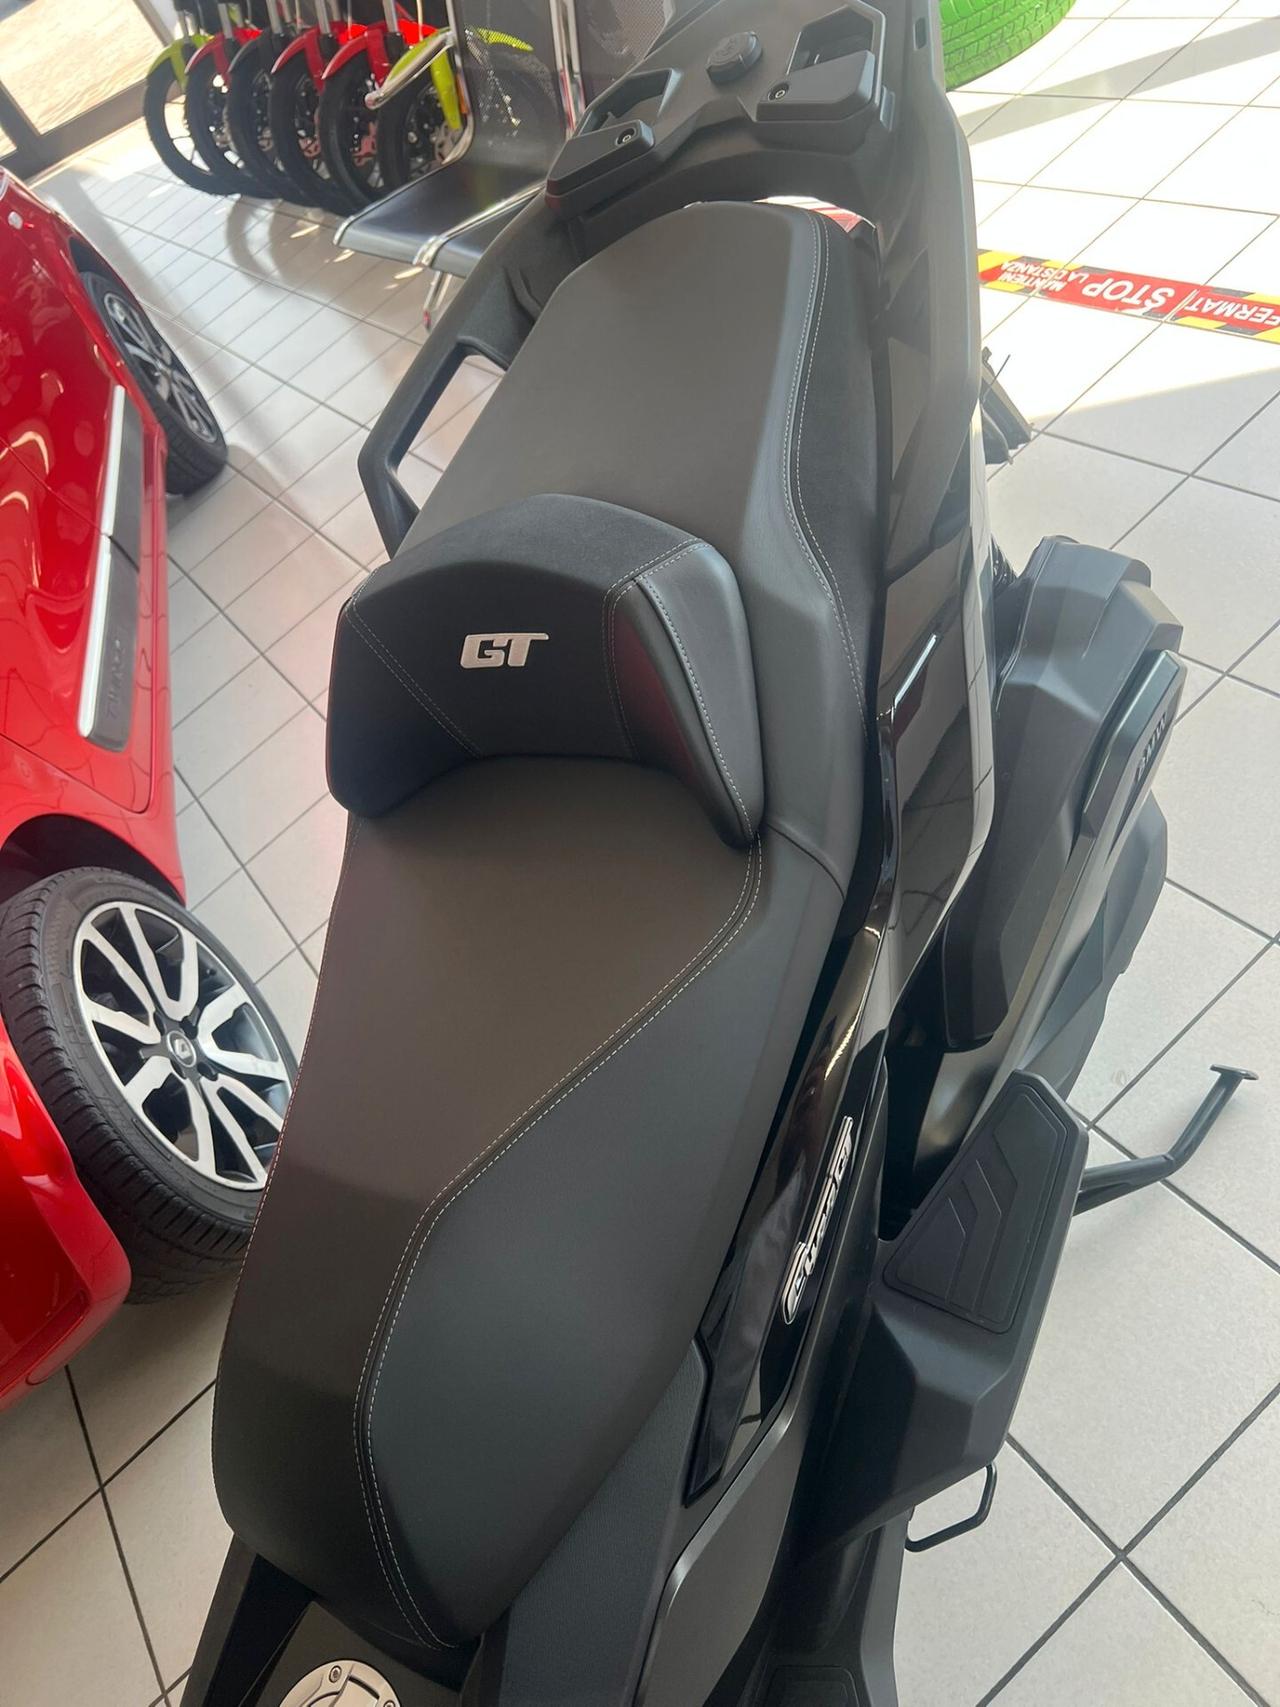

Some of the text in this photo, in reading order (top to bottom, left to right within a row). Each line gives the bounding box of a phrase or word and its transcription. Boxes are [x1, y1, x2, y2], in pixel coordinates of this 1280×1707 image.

[999, 271, 1067, 292] MANTIENI
[1001, 261, 1090, 284] LA DISTANZA
[1081, 278, 1175, 308] STOP
[460, 632, 550, 669] GT
